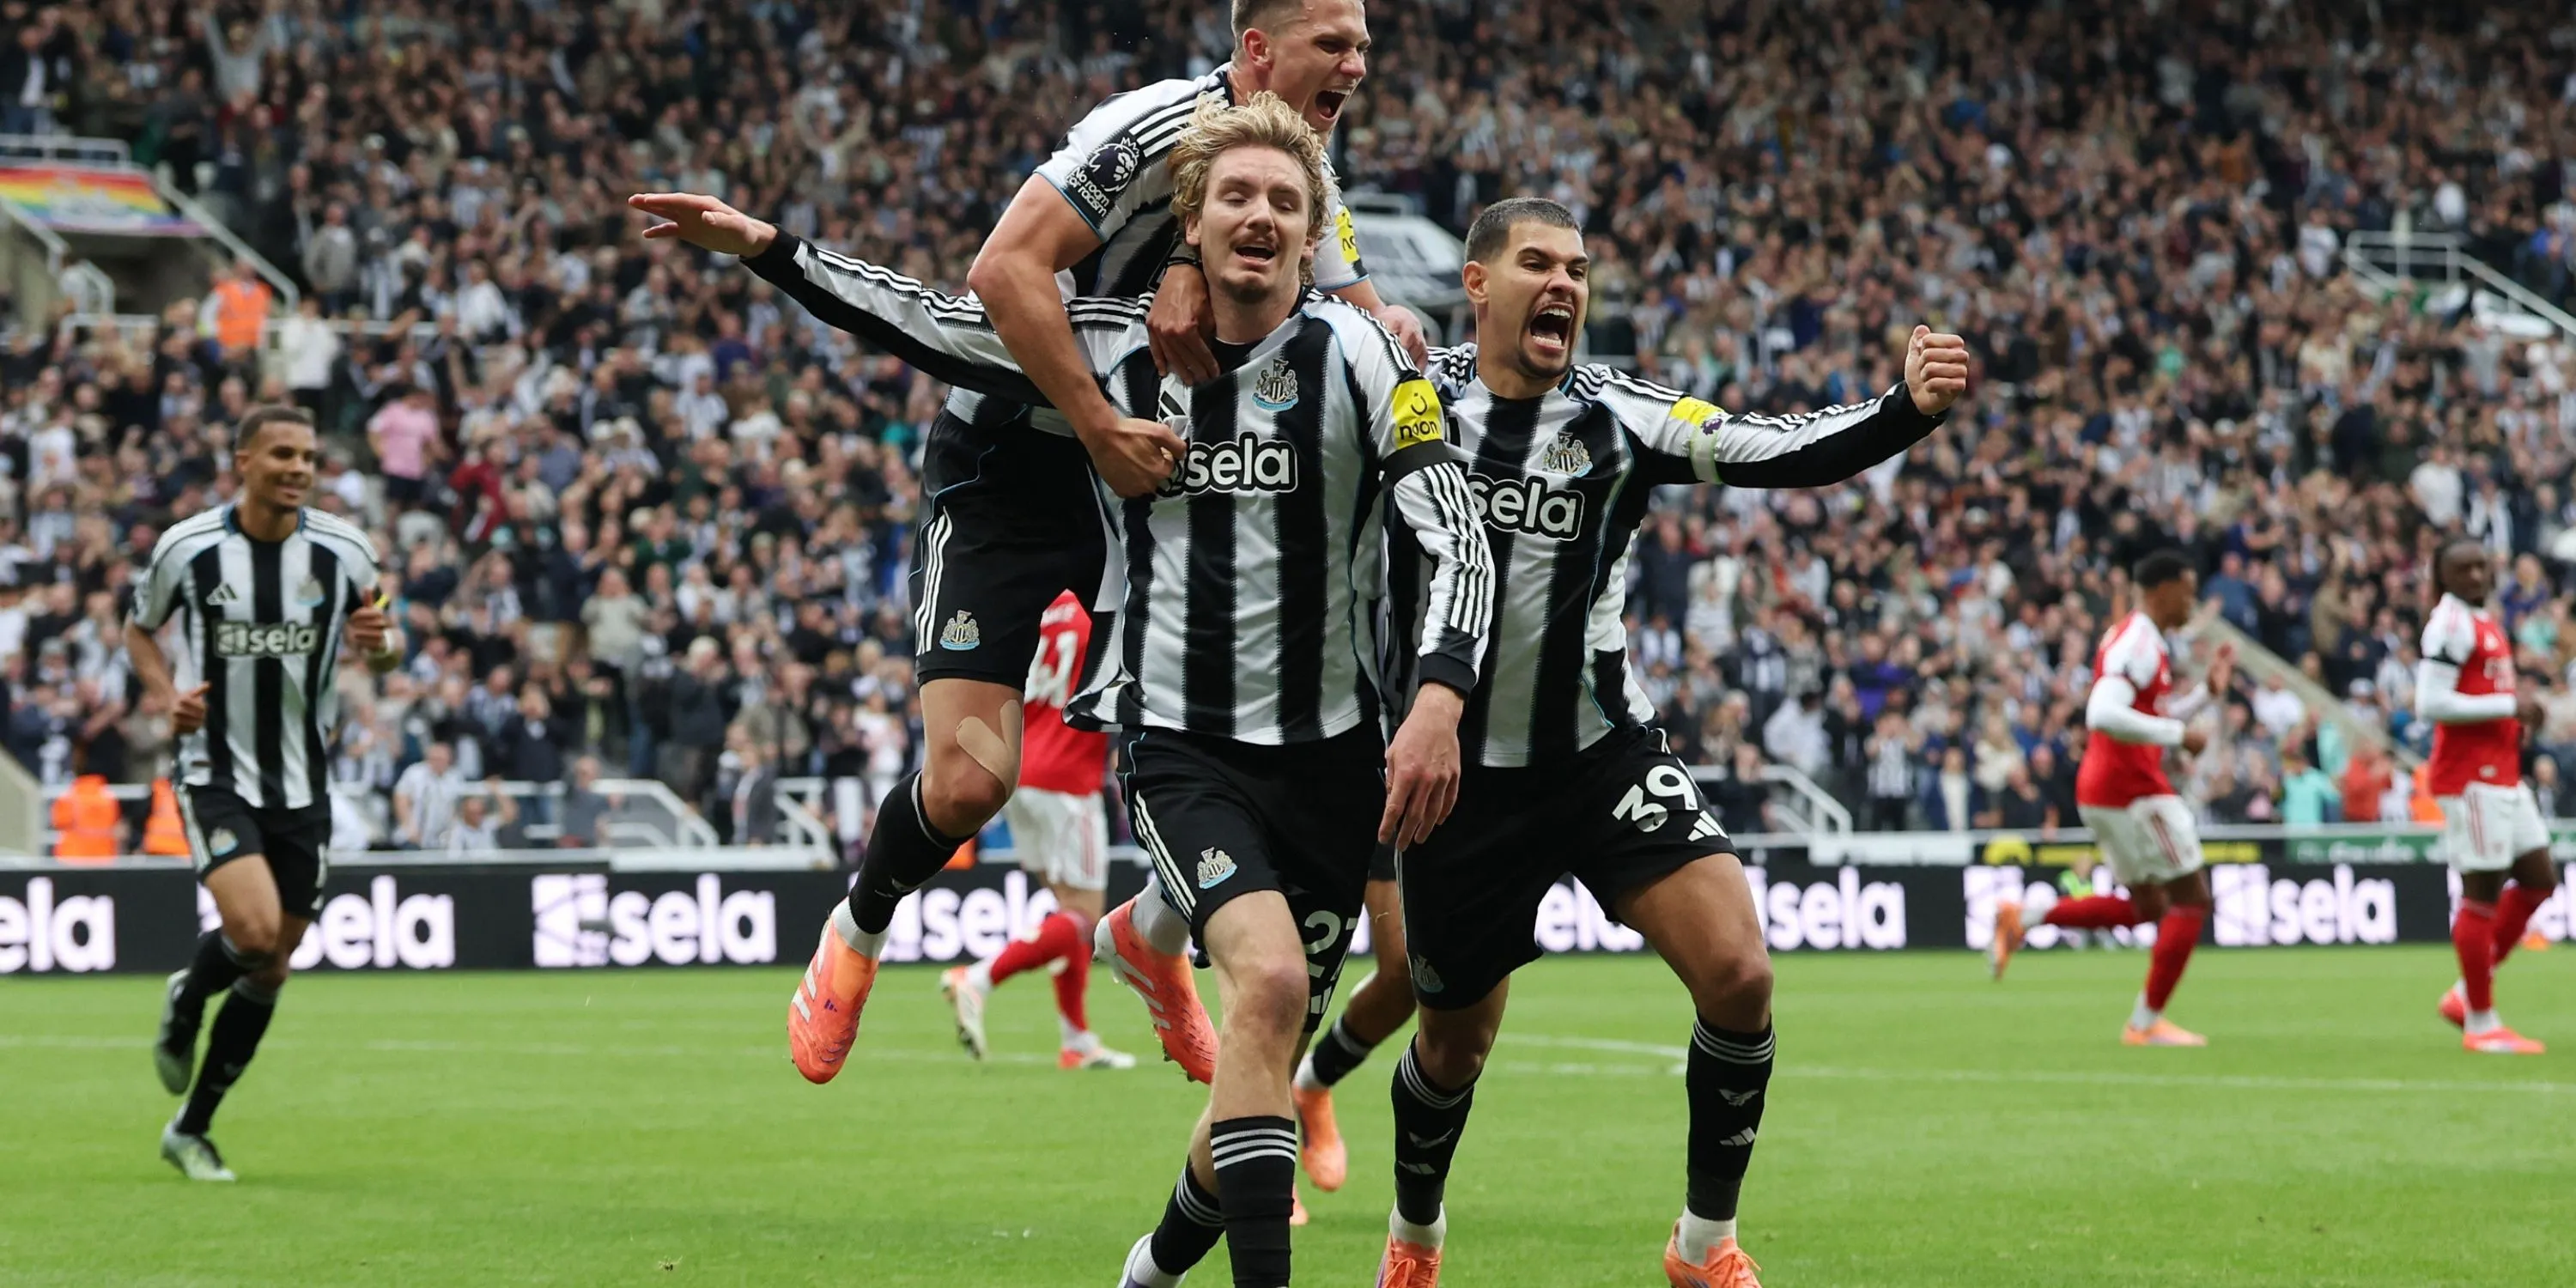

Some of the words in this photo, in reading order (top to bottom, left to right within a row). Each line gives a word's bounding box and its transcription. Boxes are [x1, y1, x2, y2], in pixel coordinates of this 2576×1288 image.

[1066, 167, 1087, 183] No
[1084, 180, 1109, 207] room
[1400, 421, 1439, 440] noon
[1185, 438, 1290, 487] sela
[1467, 481, 1577, 533] sela
[249, 623, 318, 653] sela
[1612, 764, 1699, 833] 39
[608, 872, 777, 966] sela
[1768, 865, 1907, 951] sela
[2269, 863, 2398, 945] sela
